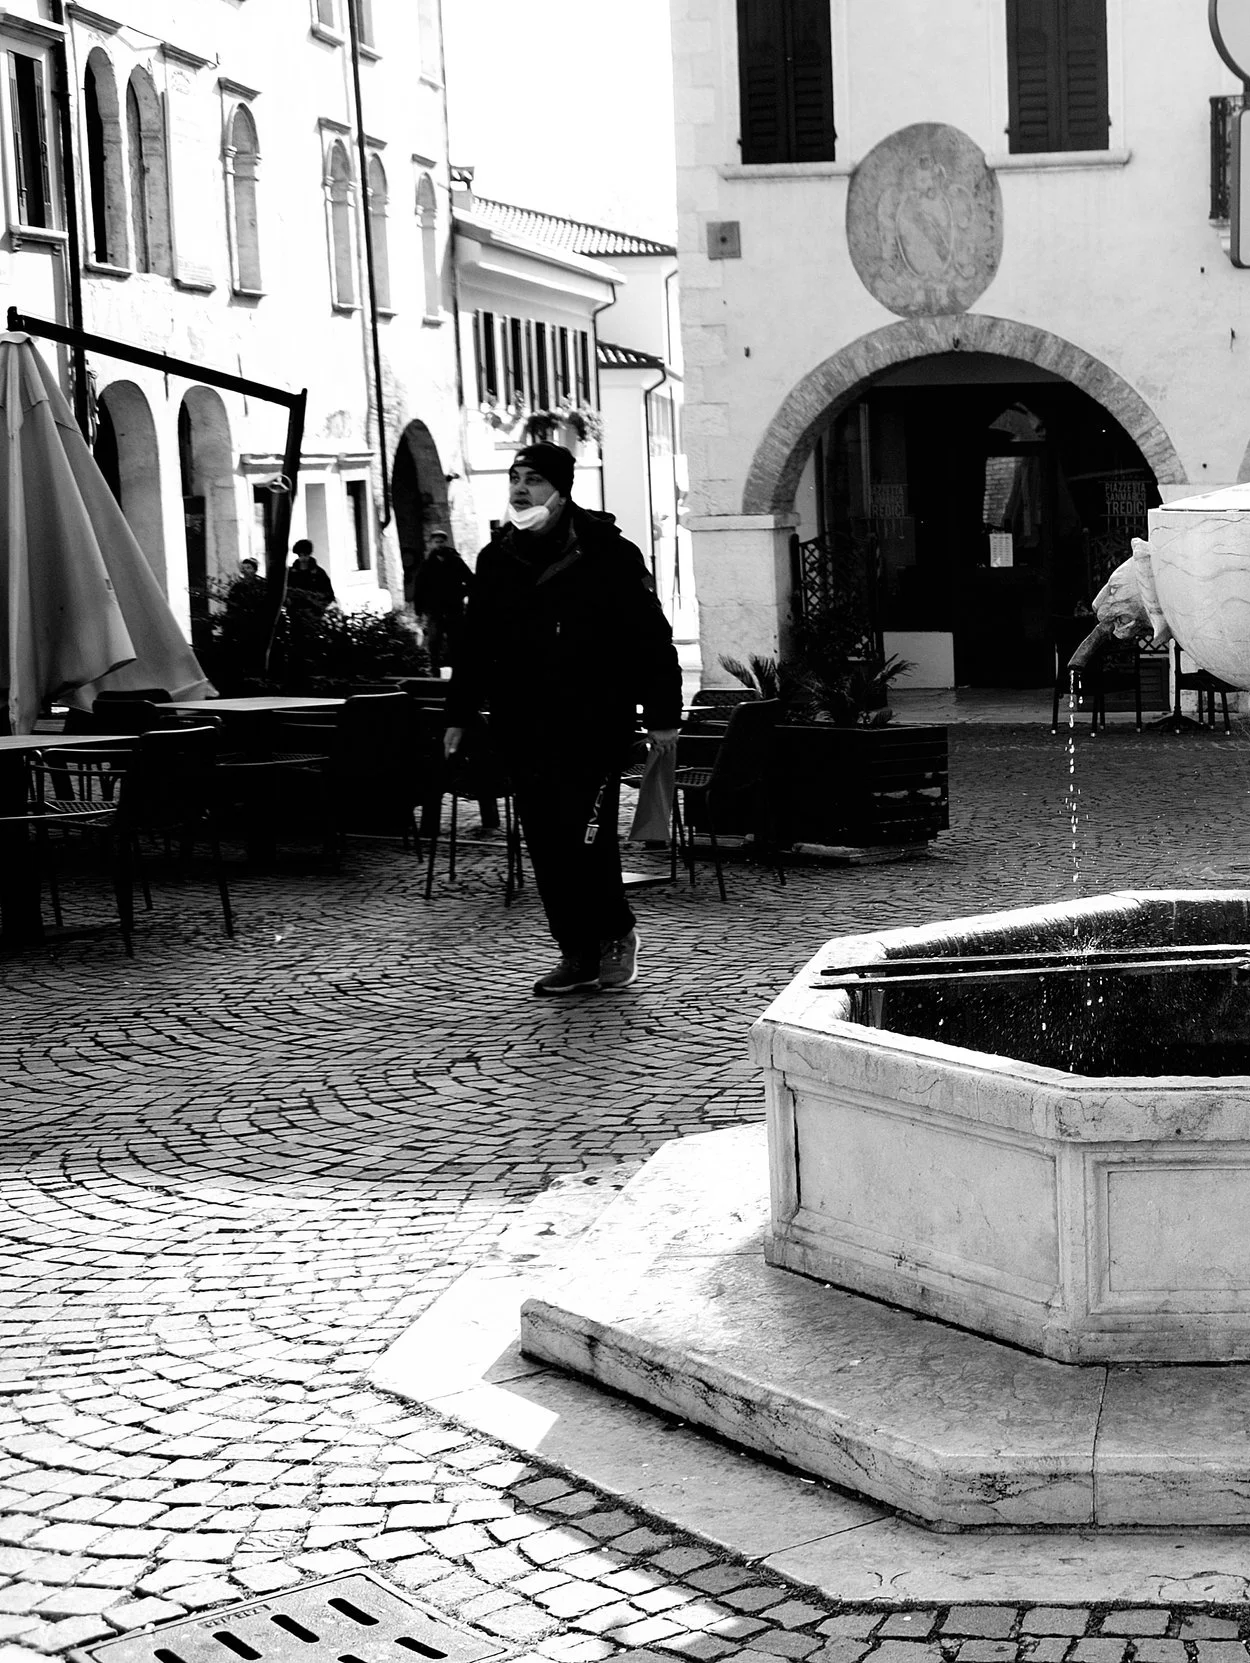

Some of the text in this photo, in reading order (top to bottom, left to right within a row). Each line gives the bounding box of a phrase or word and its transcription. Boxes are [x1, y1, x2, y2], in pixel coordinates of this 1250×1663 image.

[1105, 482, 1147, 492] PIAZZETTA
[872, 504, 904, 517] REDICI
[1105, 501, 1147, 514] TREDICI
